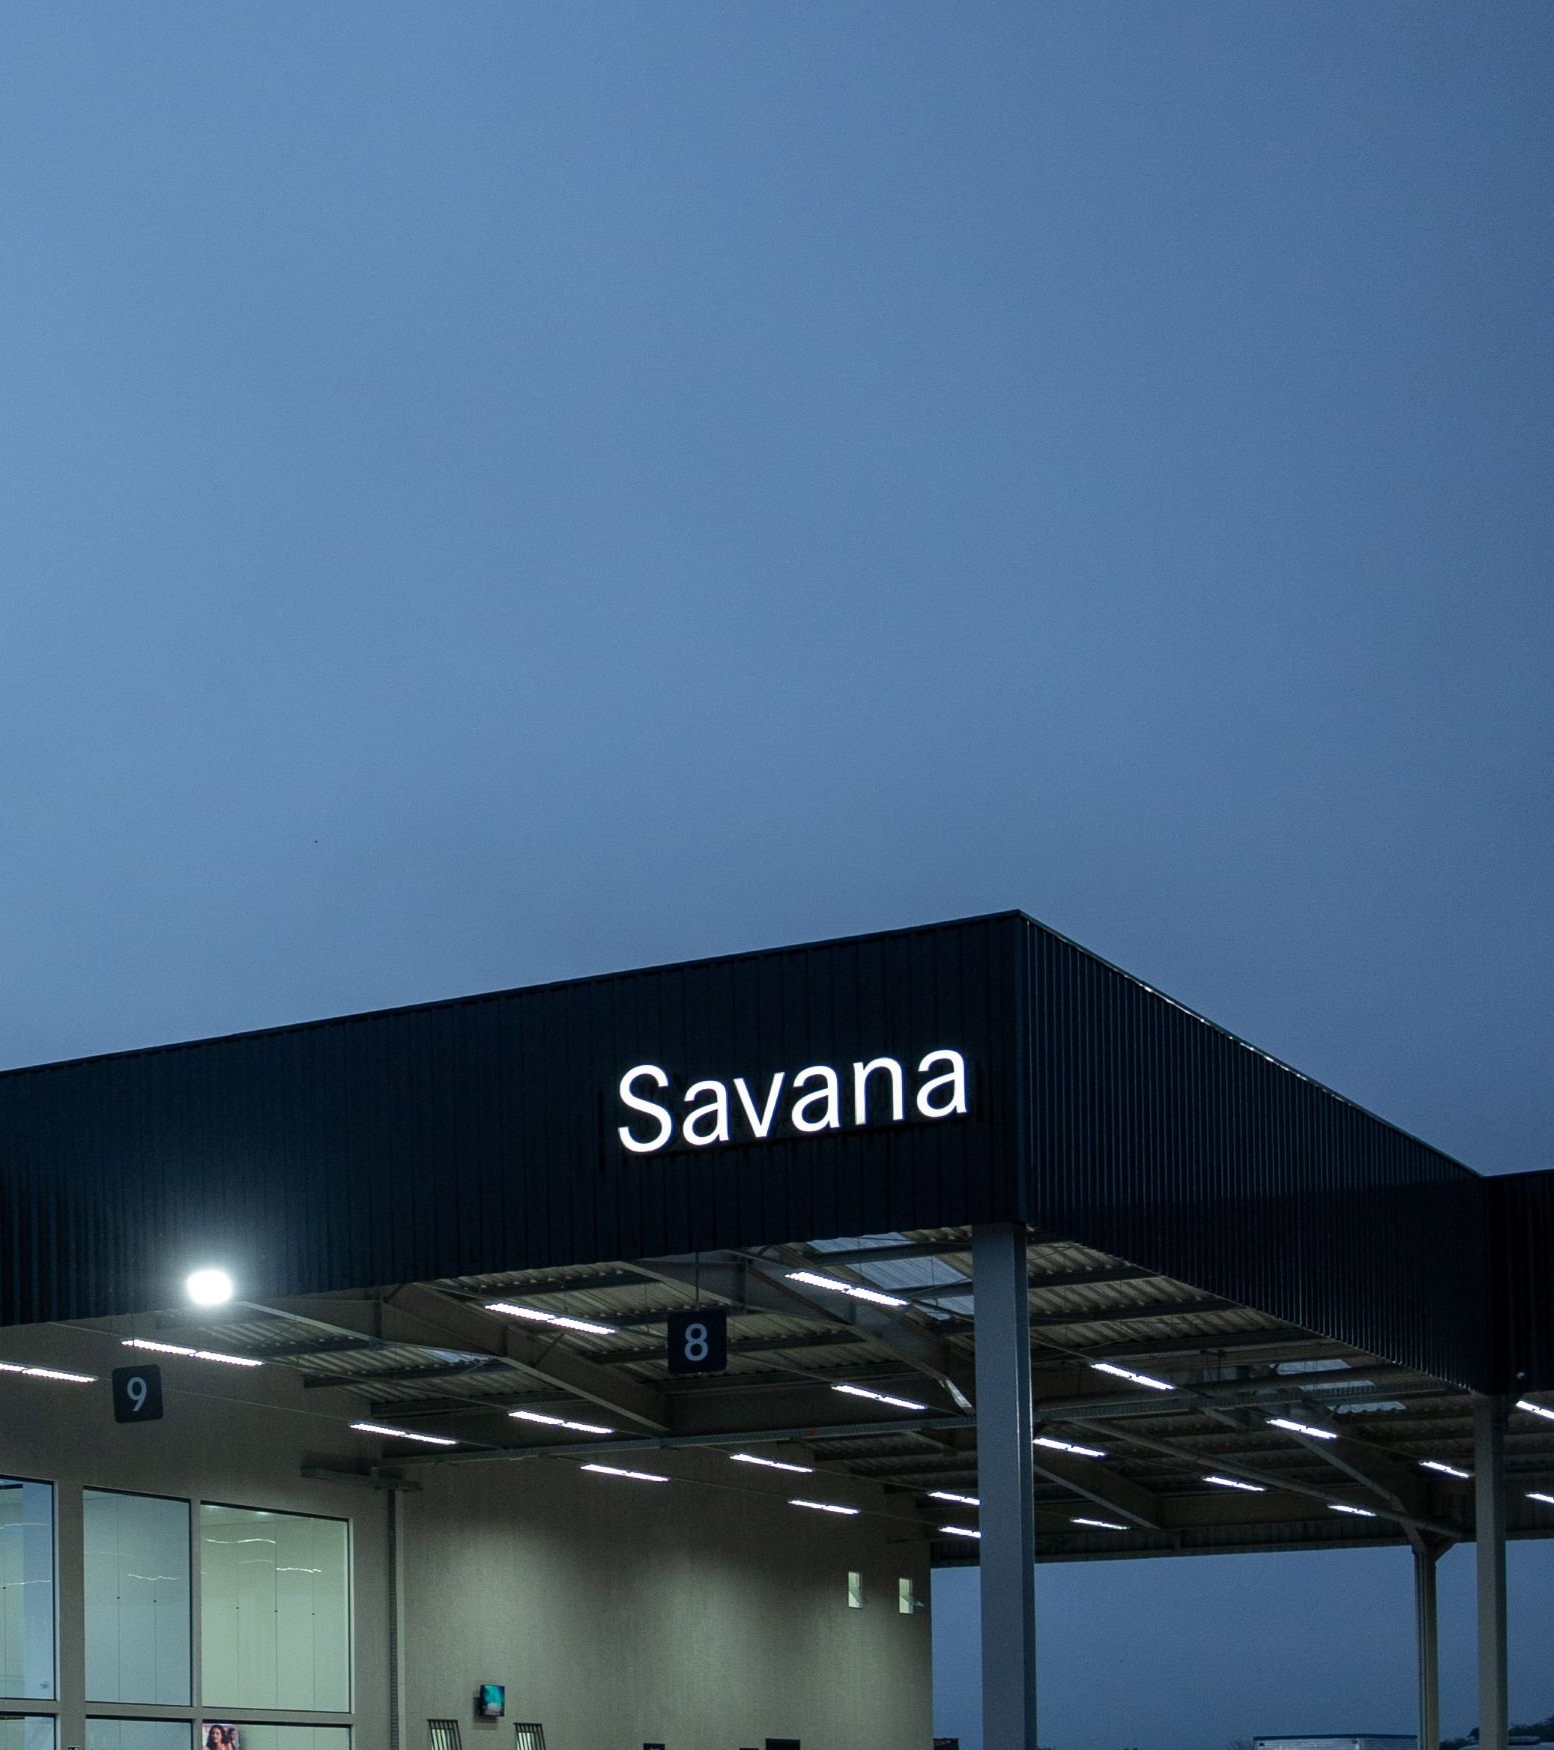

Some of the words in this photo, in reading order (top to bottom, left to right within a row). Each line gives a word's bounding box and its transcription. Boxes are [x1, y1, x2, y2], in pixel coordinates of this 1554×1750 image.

[617, 1049, 967, 1153] Savana
[685, 1323, 708, 1361] 8
[127, 1376, 147, 1411] 9
